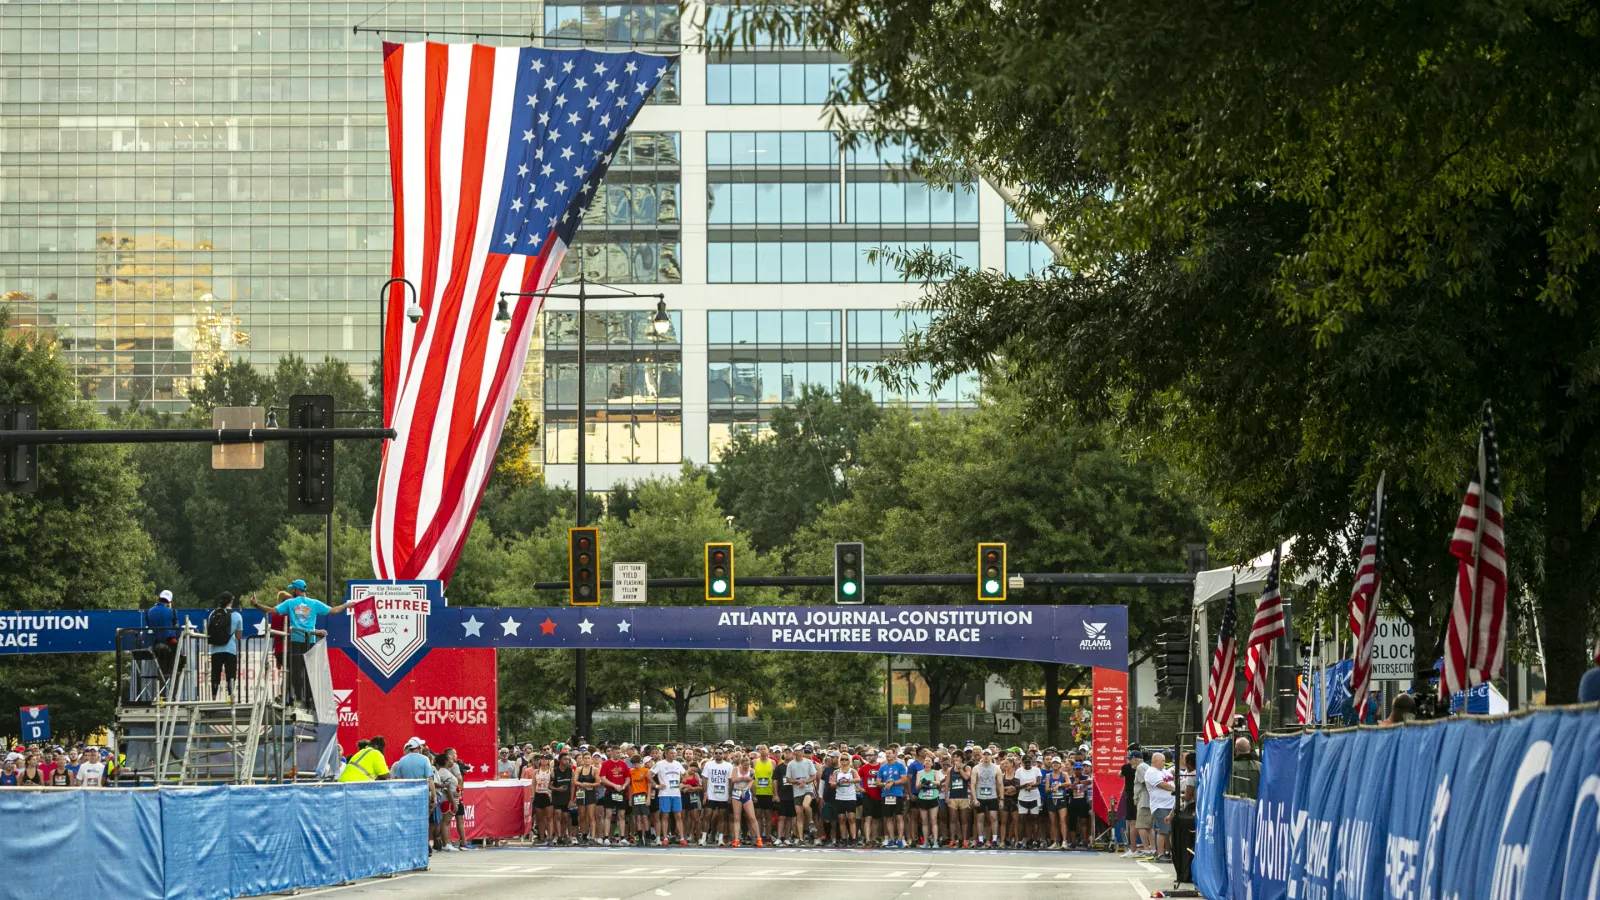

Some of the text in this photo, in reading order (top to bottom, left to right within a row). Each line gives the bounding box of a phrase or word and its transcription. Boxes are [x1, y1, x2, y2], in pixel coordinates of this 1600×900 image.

[376, 599, 429, 612] CHTREE
[0, 616, 88, 630] STITUTION
[718, 610, 1032, 626] ATLANTA JOURNAL-CONSTITUTION
[380, 626, 398, 635] COX
[772, 628, 980, 642] PEACHTREE ROAD RACE
[1392, 623, 1410, 638] NO
[1372, 662, 1414, 674] NTERSECTIO
[413, 696, 487, 710] RUNNING
[1000, 702, 1016, 710] JCT
[414, 710, 488, 724] CITY USA
[998, 718, 1016, 730] 141
[32, 726, 42, 738] D
